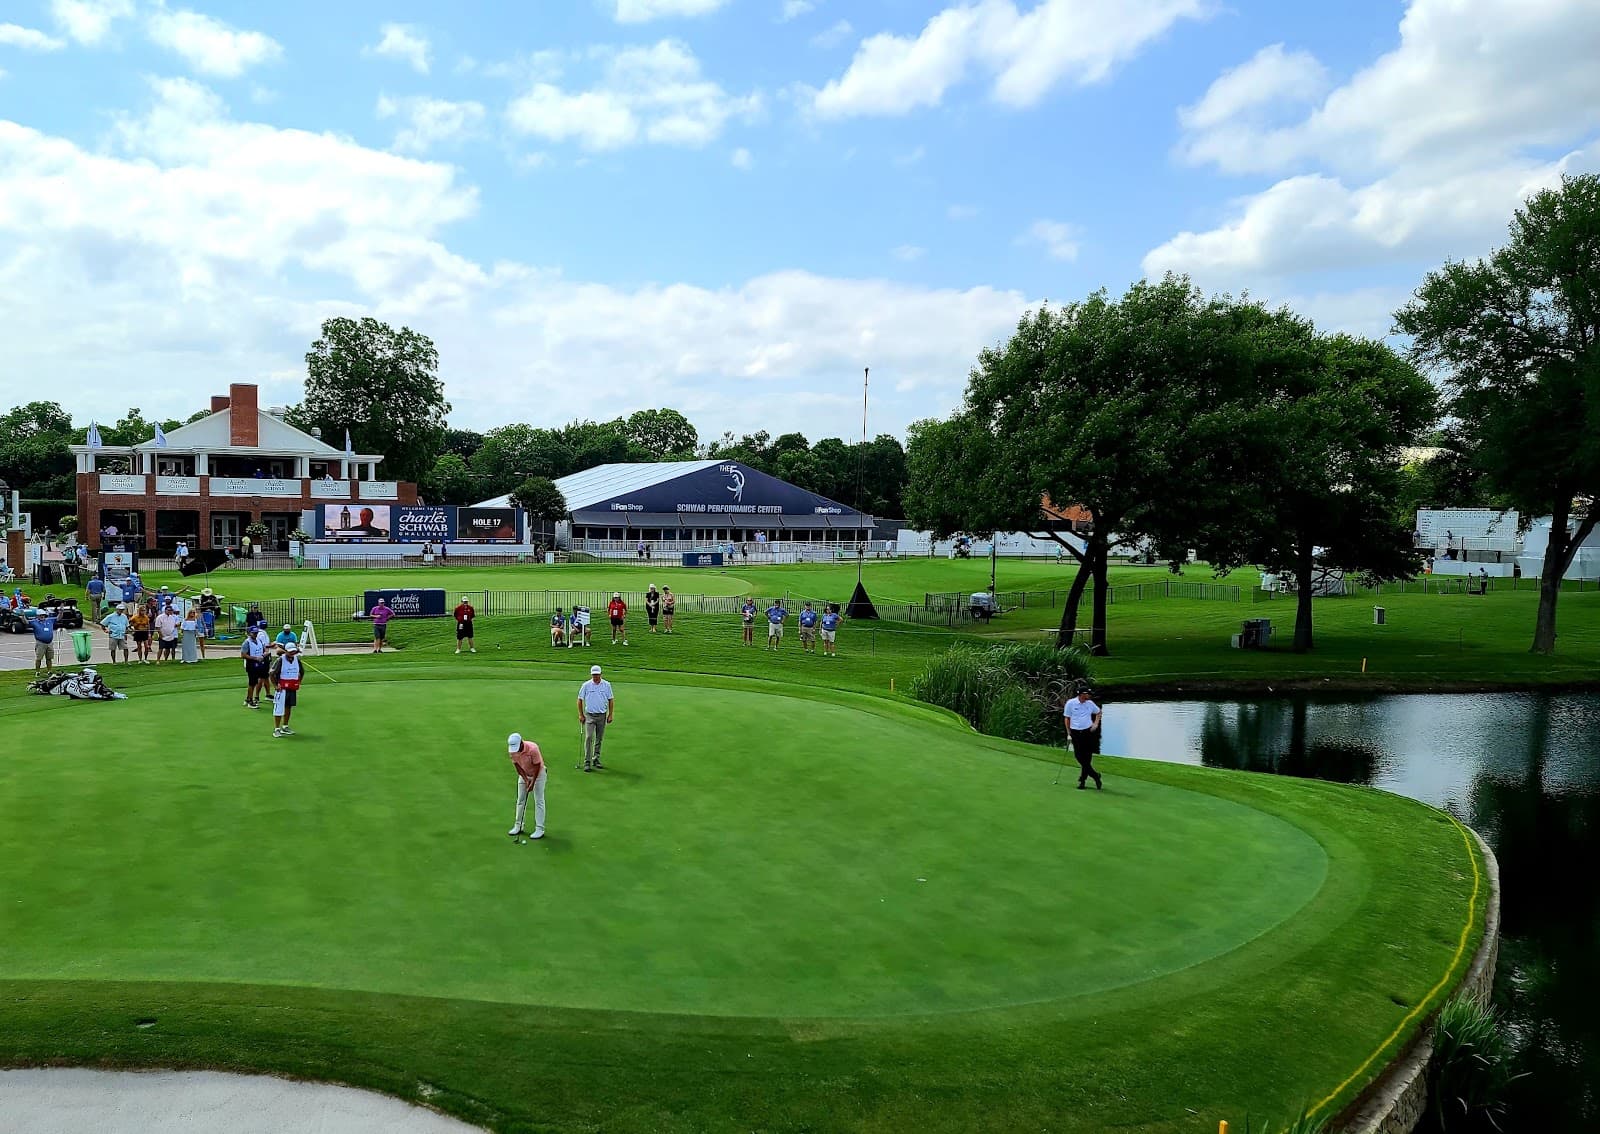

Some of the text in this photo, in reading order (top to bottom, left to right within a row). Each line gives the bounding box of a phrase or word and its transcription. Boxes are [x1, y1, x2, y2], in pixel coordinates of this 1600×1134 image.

[677, 503, 782, 513] SCHWAB PERFORMANCE CENTER
[398, 511, 448, 523] charles
[472, 518, 501, 526] HOLE 17
[398, 523, 448, 532] SCHWAB
[390, 594, 420, 603] charles
